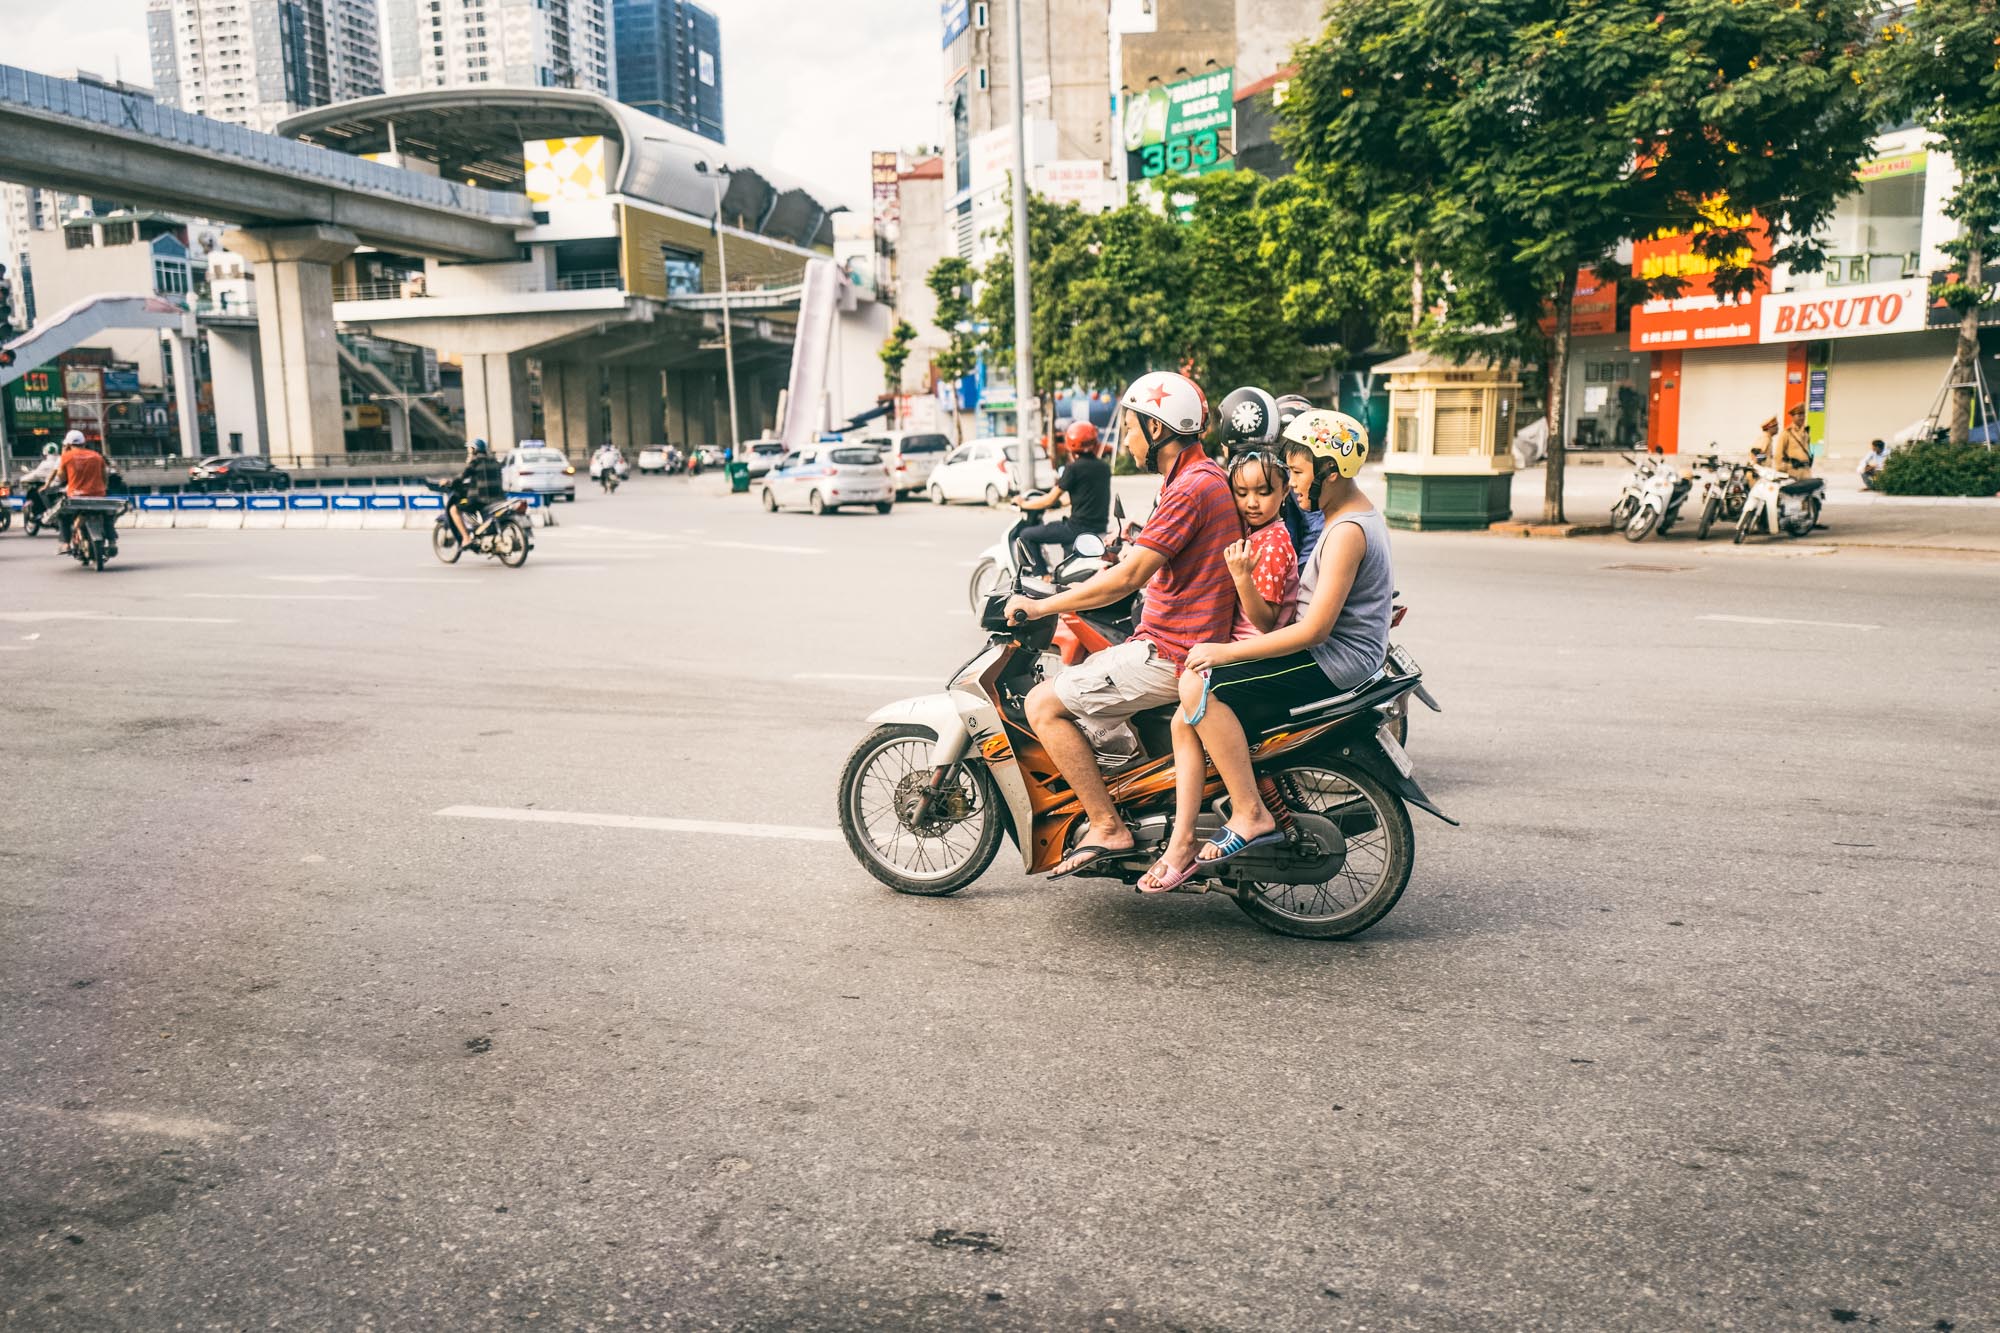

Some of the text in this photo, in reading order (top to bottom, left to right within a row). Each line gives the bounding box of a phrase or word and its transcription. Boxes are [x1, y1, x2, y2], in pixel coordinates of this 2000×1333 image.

[1142, 131, 1219, 177] 363
[1774, 293, 1903, 334] BESUTO
[24, 372, 49, 391] LED
[145, 408, 168, 425] in
